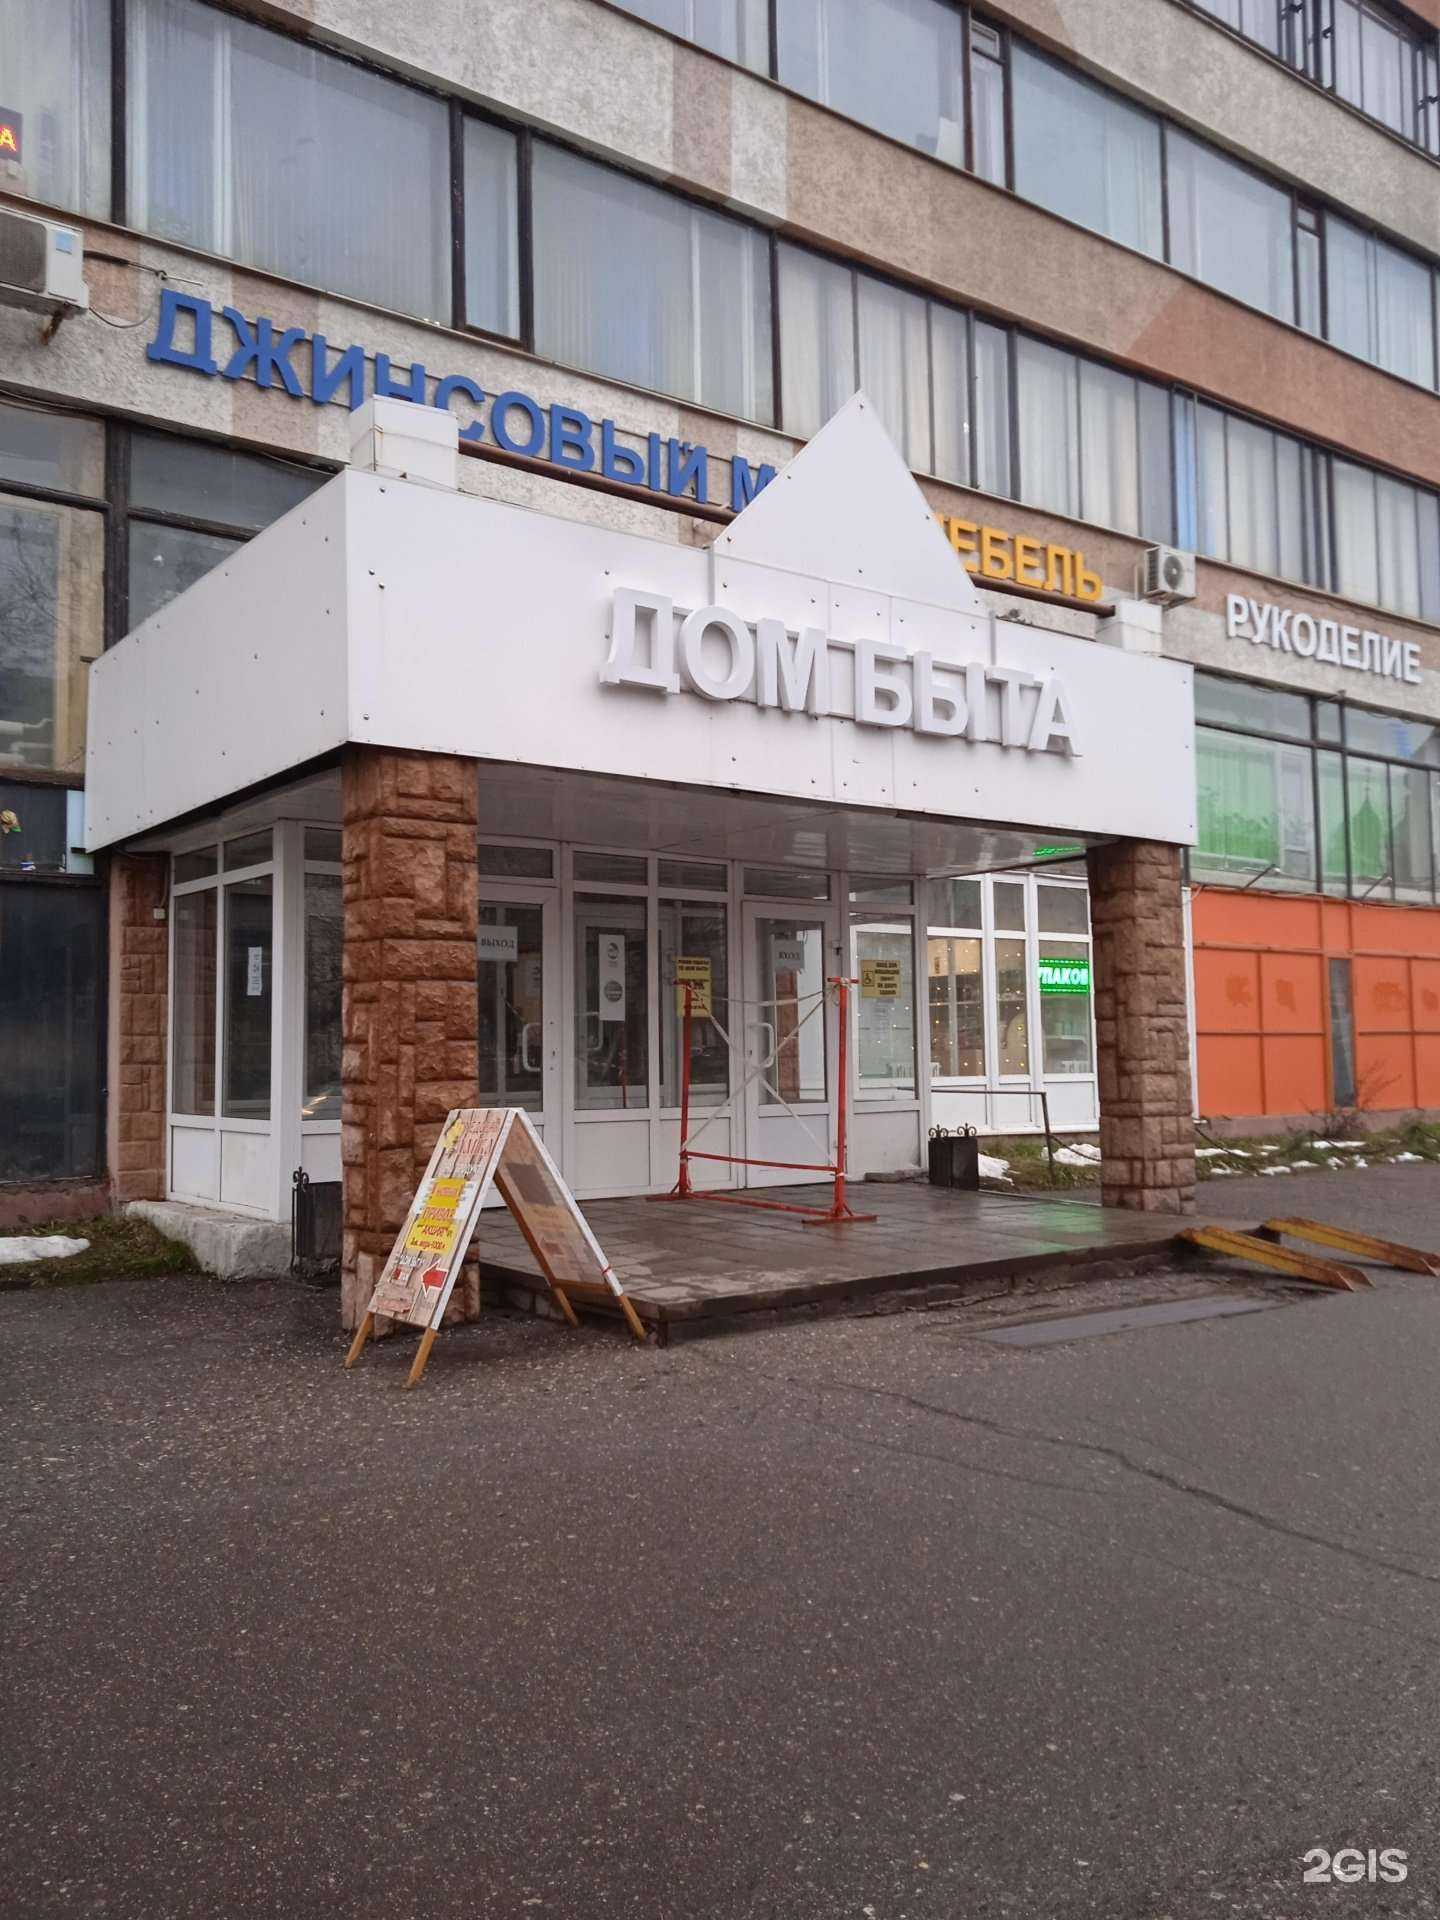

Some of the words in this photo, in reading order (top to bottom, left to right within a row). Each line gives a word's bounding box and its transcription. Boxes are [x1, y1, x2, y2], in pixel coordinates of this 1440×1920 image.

[146, 289, 708, 505] ДЖИНСОВЫЙ
[934, 513, 1103, 602] ЕБЕЛЬ
[600, 586, 829, 716] ДОМ
[854, 637, 1080, 757] БЫТА
[1226, 593, 1423, 685] РУКОДЕЛИЕ
